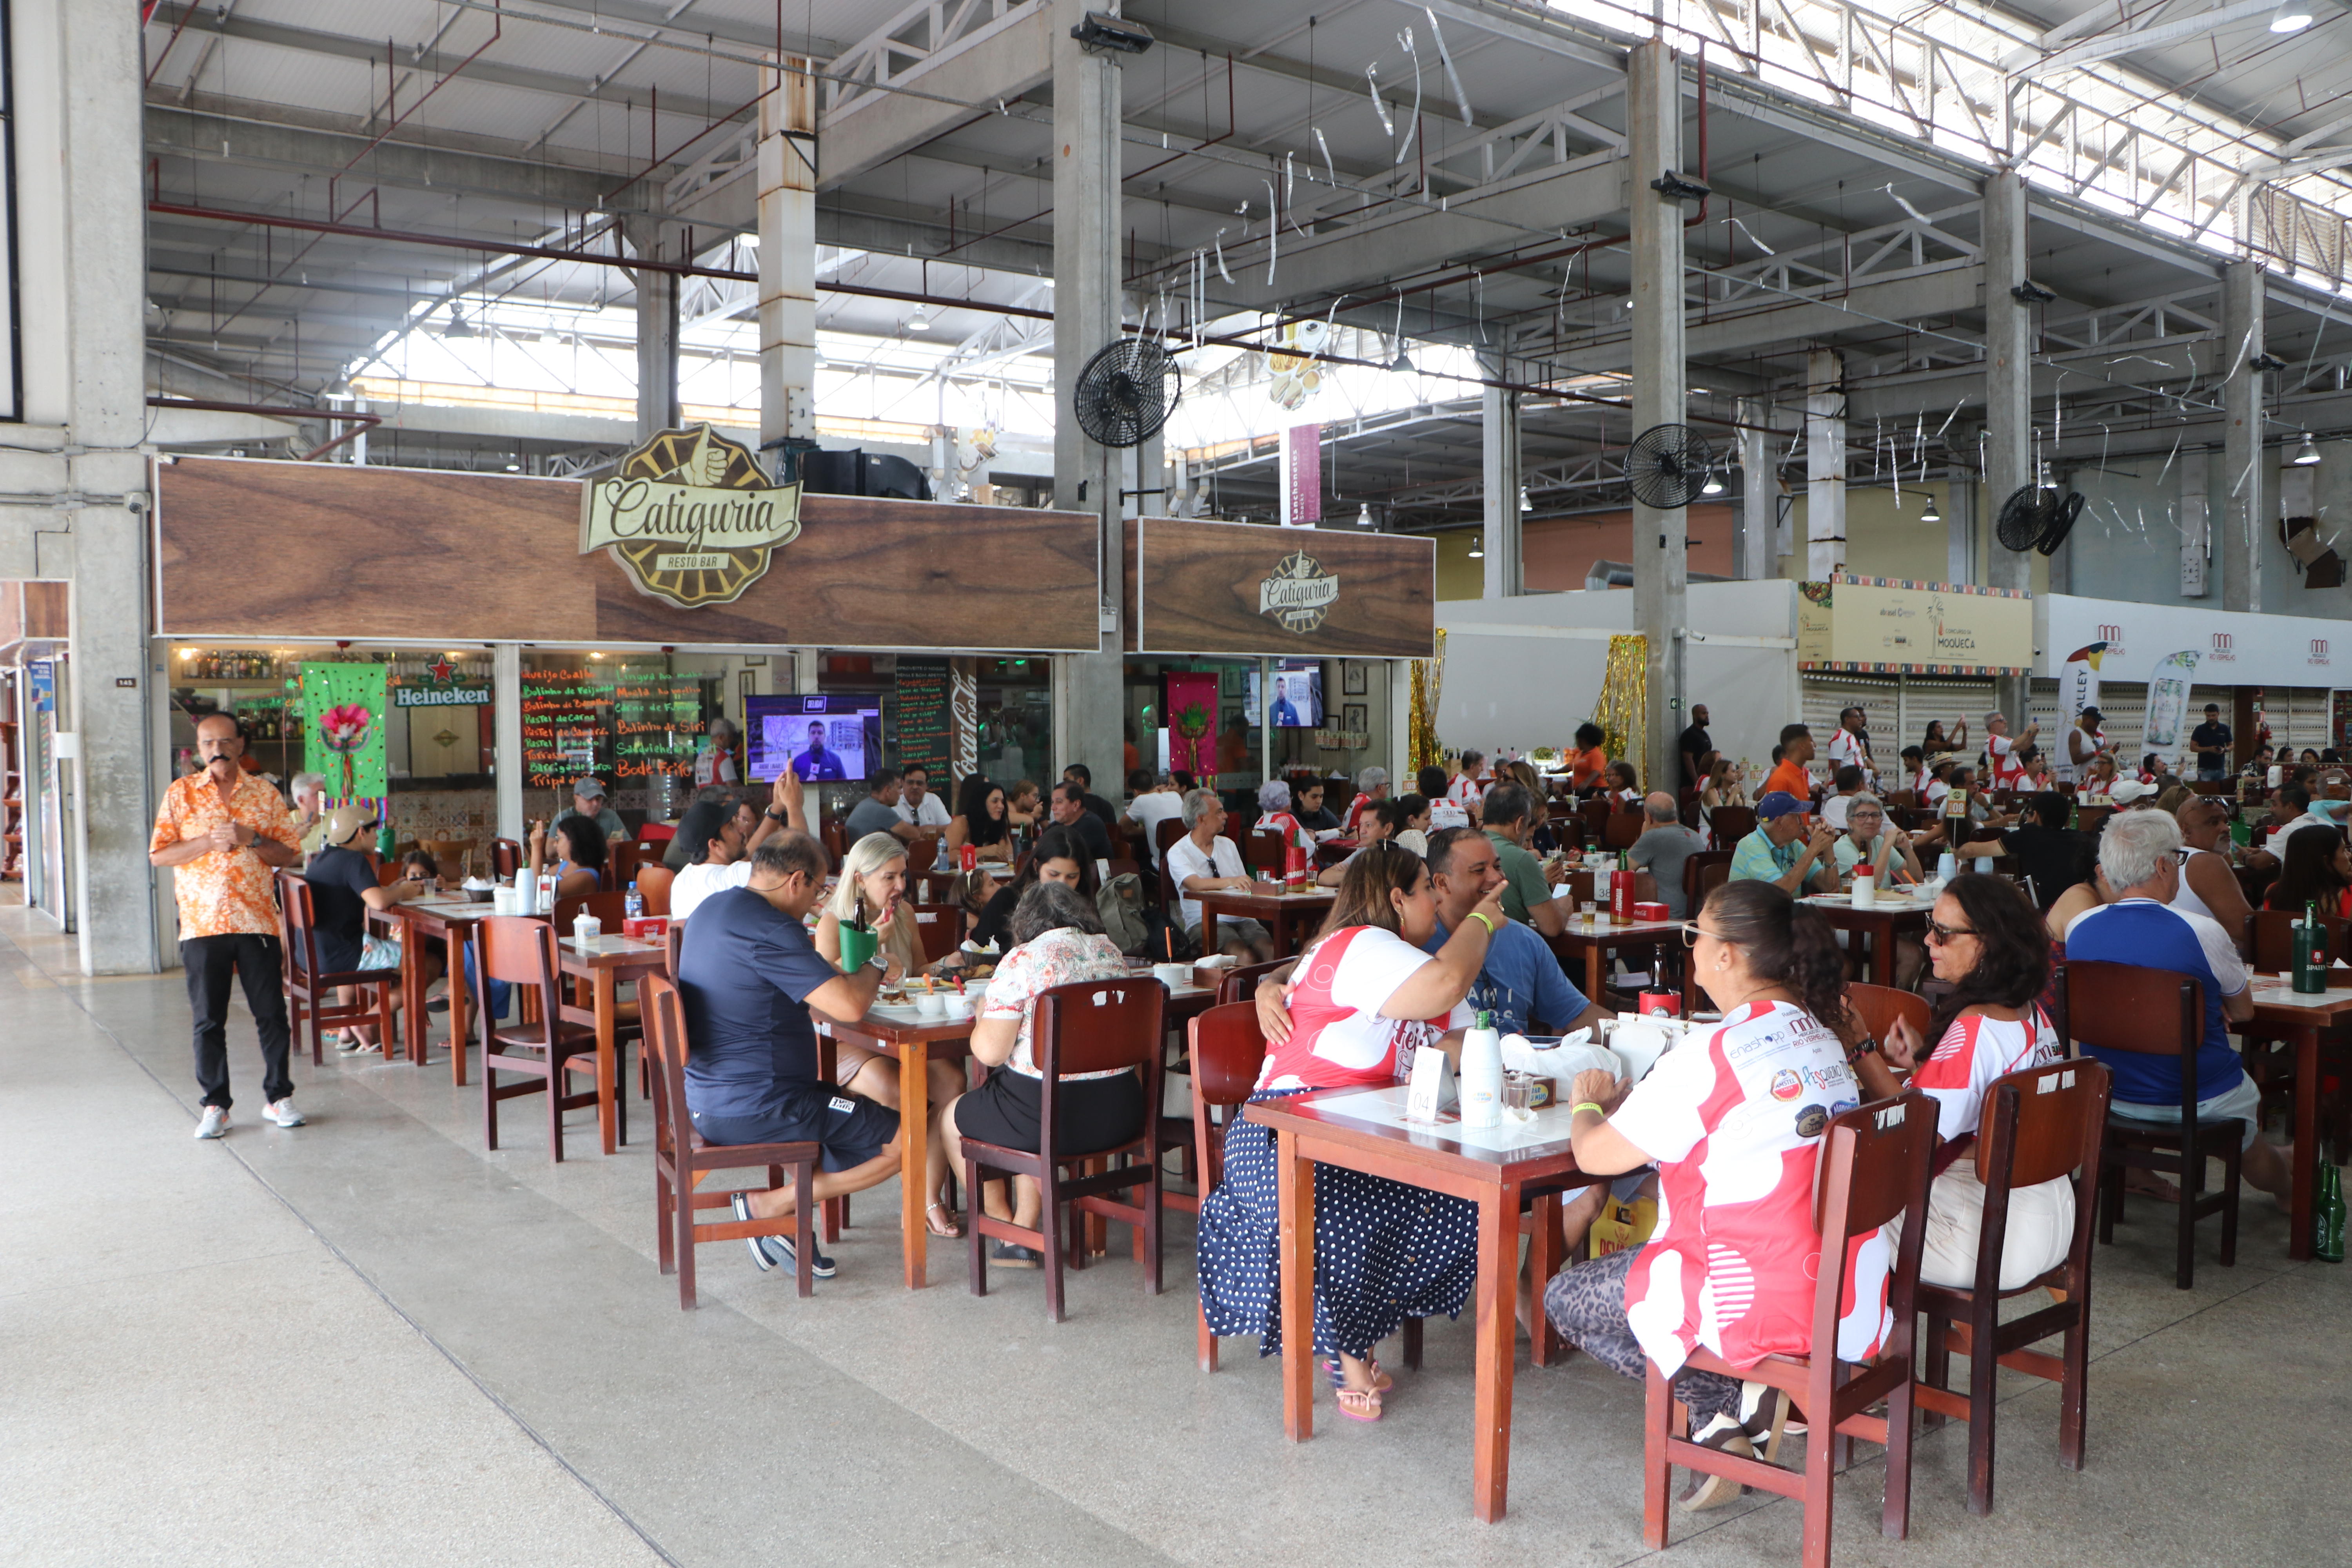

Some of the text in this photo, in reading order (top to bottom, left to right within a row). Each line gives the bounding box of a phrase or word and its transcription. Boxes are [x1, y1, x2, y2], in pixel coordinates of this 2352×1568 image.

[604, 479, 797, 552] Catiguria
[700, 556, 717, 567] BAR
[1265, 579, 1339, 610] Catiguria
[1938, 637, 1975, 649] MOQUECA
[396, 686, 490, 706] Heineken
[522, 684, 562, 698] Bolinho
[2075, 669, 2088, 717] VALLEY
[522, 700, 561, 712] Bolinho
[649, 703, 662, 711] de
[616, 719, 705, 735] Bolinho de Siri
[615, 759, 654, 777] Bode
[529, 773, 565, 789] Tripa
[1953, 802, 1964, 813] 08
[1798, 1030, 1814, 1038] MERCADO
[1805, 1033, 1828, 1044] VERMELHO
[1775, 1078, 1796, 1089] AMSTEL
[1414, 1092, 1429, 1112] 04
